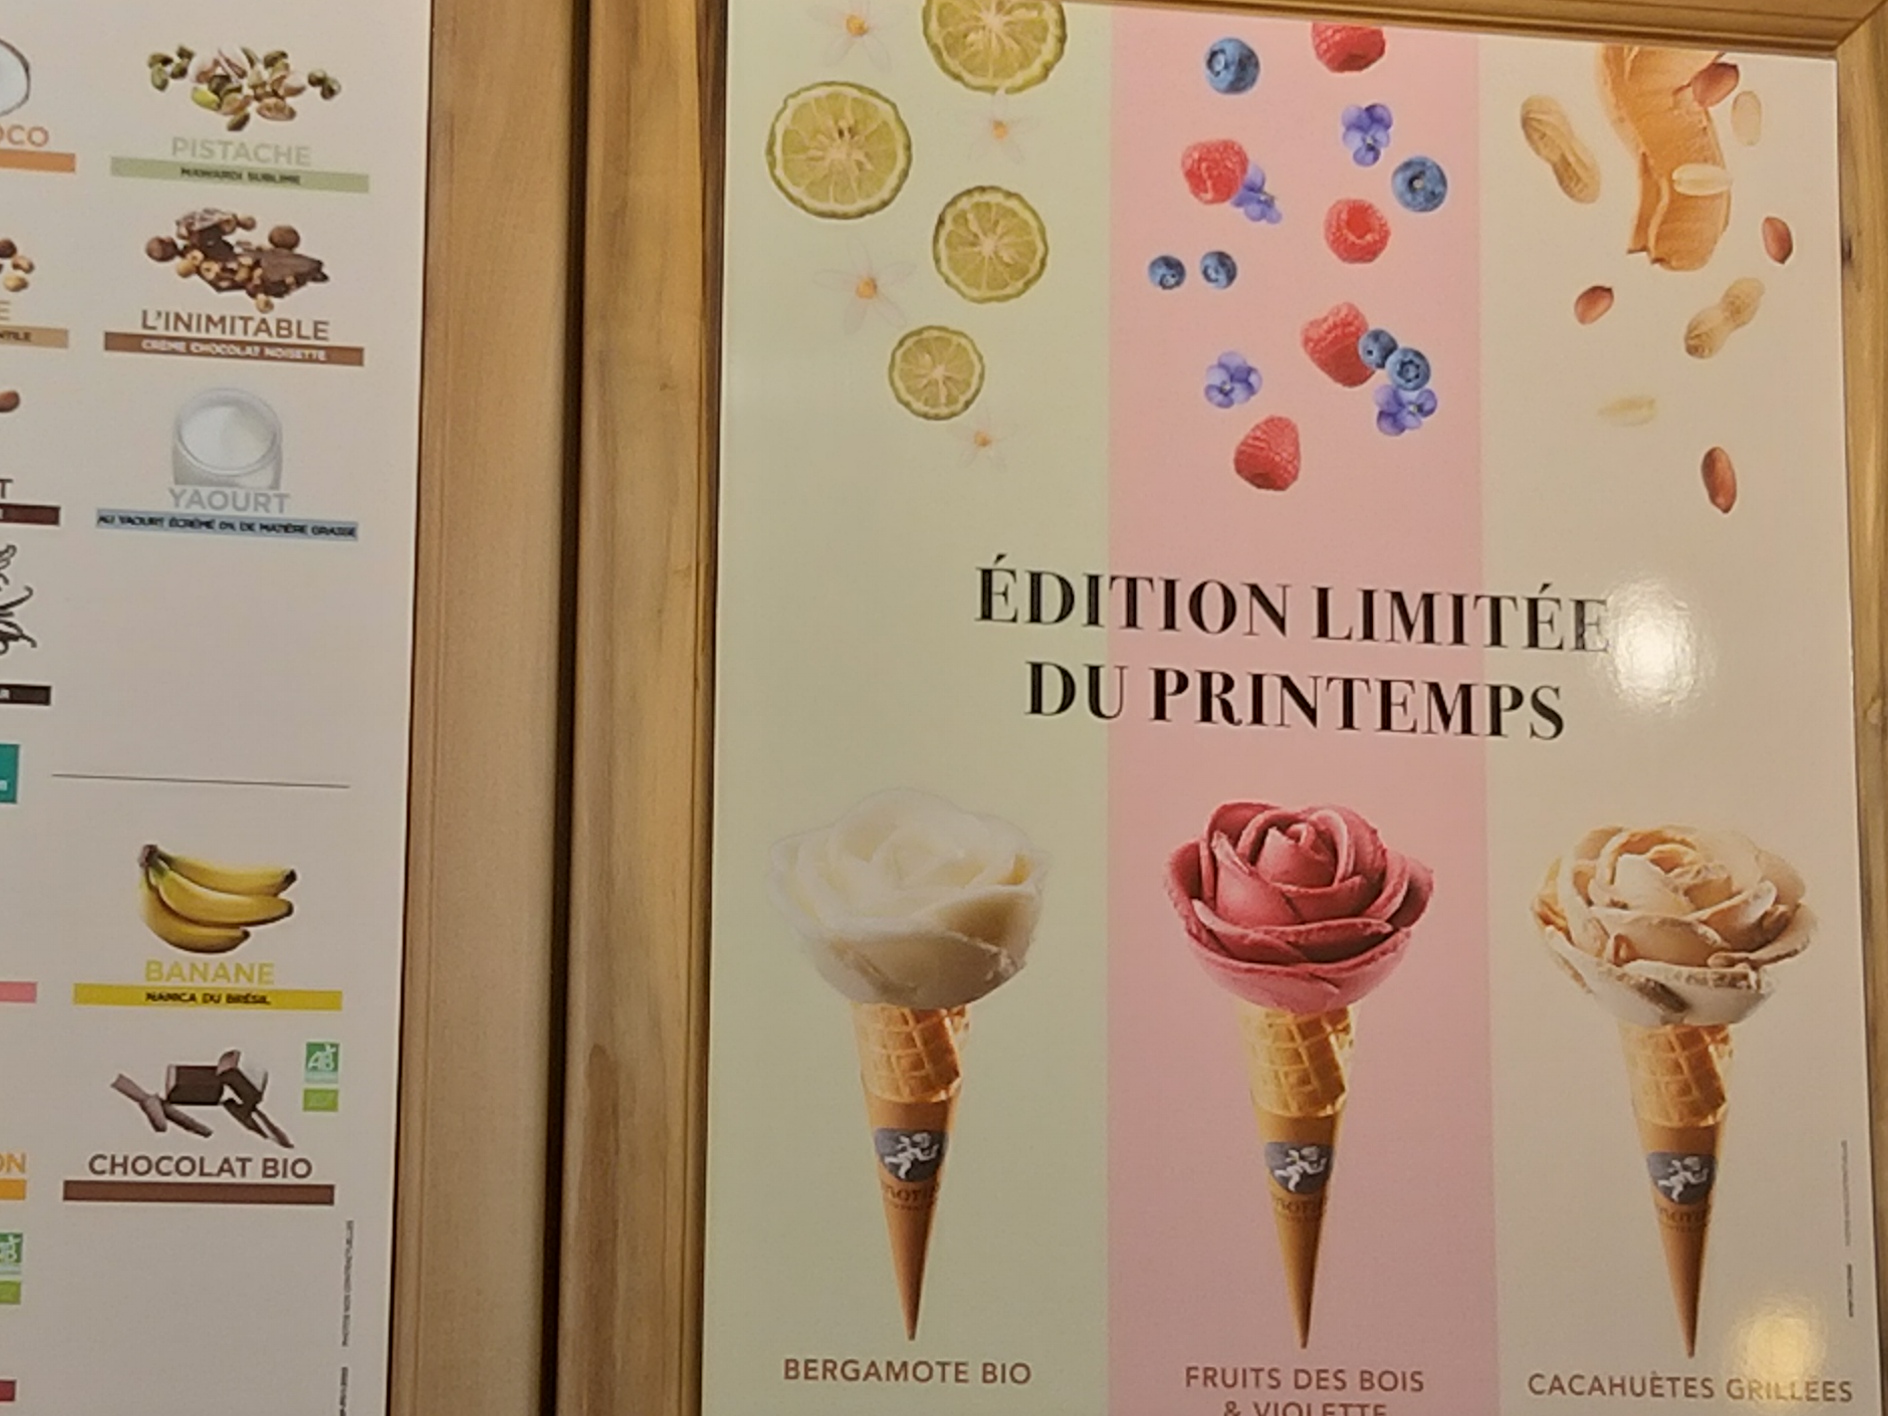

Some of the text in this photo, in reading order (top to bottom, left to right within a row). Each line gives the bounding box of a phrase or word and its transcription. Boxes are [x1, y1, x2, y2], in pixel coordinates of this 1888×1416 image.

[171, 135, 312, 168] PISTACHE
[140, 307, 331, 342] L'INIMITABLE
[168, 486, 290, 516] YAOURT
[975, 553, 1610, 655] ÉDITION LIMITÉE
[1024, 660, 1566, 742] DU PRINTEMPS
[144, 959, 276, 986] BANANE
[88, 1152, 313, 1180] CHOCOLAT BIO
[783, 1357, 1032, 1385] BERGAMOTE BIO
[1184, 1365, 1425, 1394] FRUITS DES BOIS
[1526, 1367, 1854, 1406] CACAHUÈTES GRILLÉES
